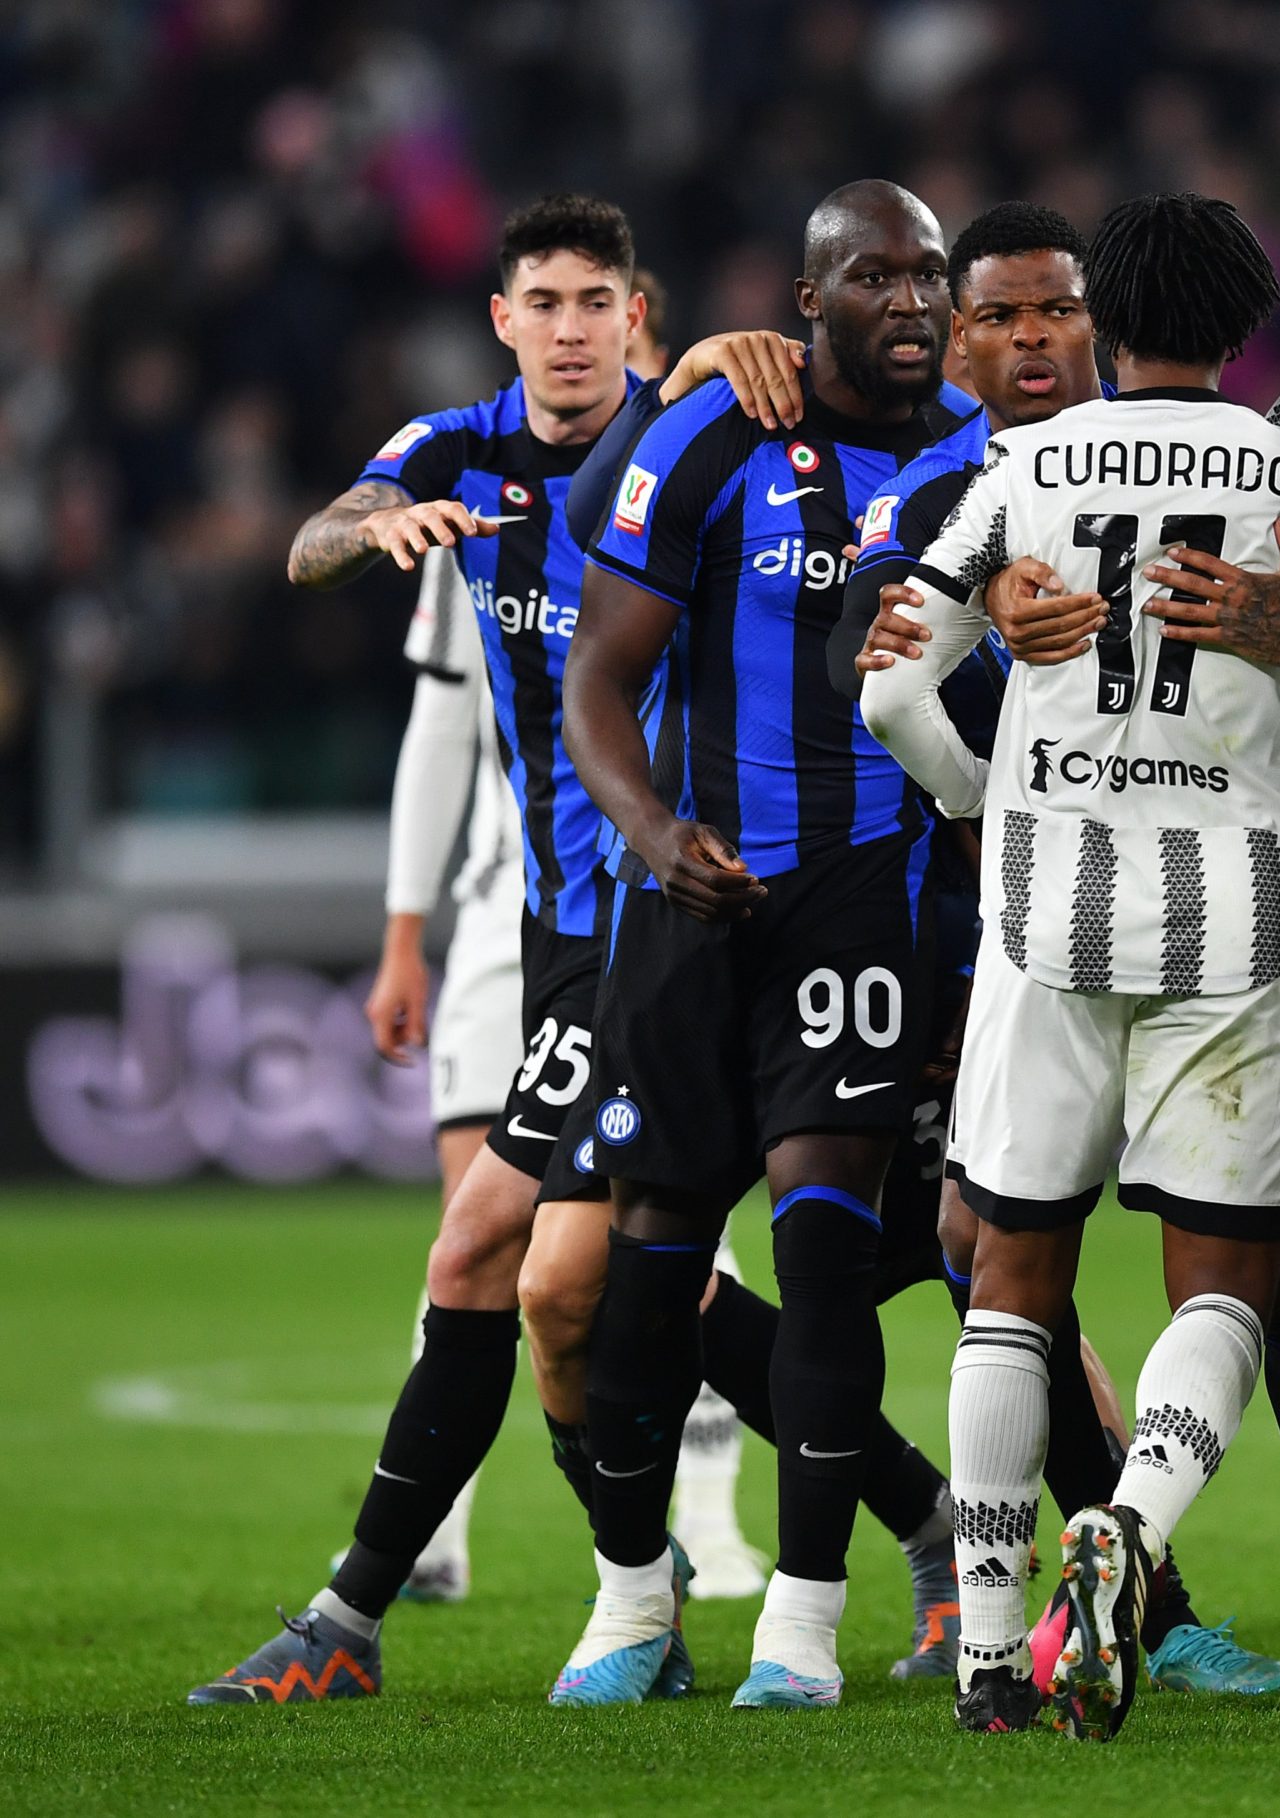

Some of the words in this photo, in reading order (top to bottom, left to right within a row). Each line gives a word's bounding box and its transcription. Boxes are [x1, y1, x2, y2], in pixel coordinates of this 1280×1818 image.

[752, 538, 857, 590] digi
[1072, 513, 1227, 718] 11
[1059, 750, 1230, 793] Cygames
[798, 966, 902, 1049] 90
[517, 1016, 593, 1106] 95
[961, 1574, 1019, 1588] adidas
